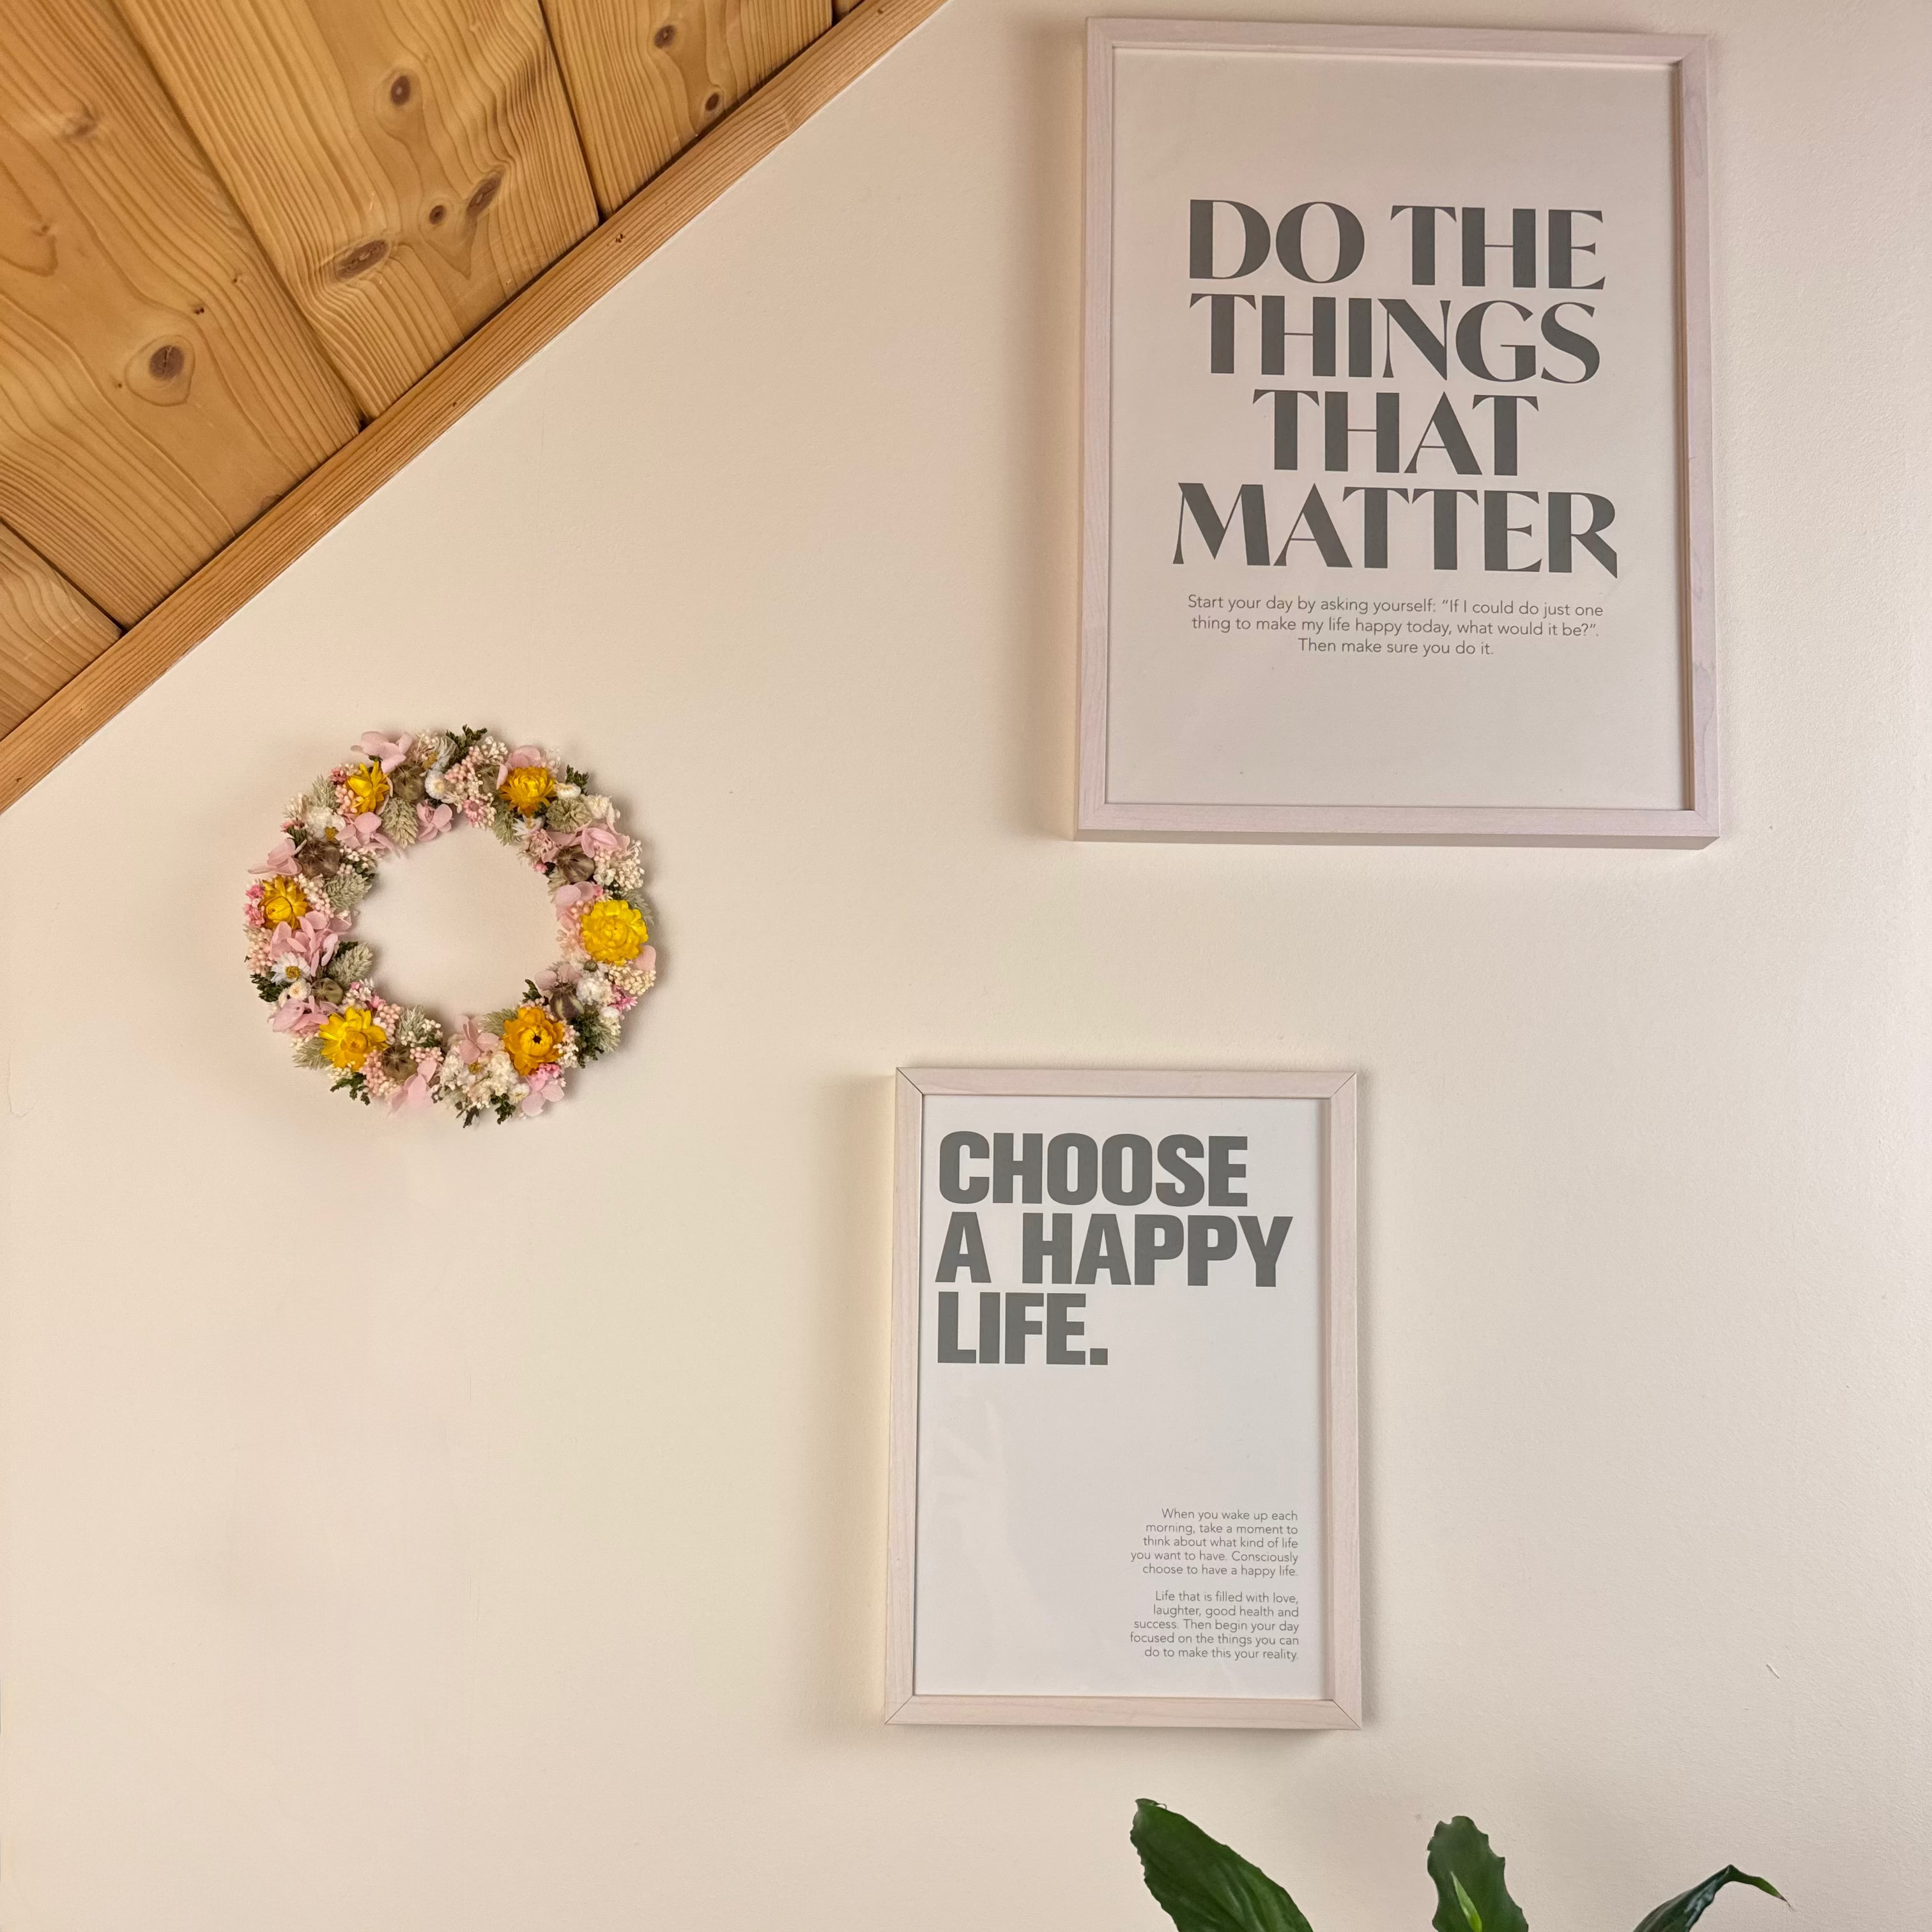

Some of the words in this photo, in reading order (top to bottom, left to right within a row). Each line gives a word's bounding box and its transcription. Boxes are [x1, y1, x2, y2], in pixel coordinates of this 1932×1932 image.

[1189, 199, 1365, 284] DO
[1390, 205, 1606, 290] THE
[1189, 293, 1600, 384] THINGS
[1252, 388, 1539, 476] THAT
[1172, 482, 1618, 579] MATTER
[1188, 594, 1224, 609] Start
[1228, 599, 1262, 613] your
[1266, 594, 1294, 614] day
[1298, 595, 1316, 614] by
[1321, 596, 1368, 615] asking
[1372, 597, 1436, 615] yourself:
[1464, 599, 1467, 613] I
[1472, 599, 1514, 615] could
[1519, 600, 1539, 615] do
[1542, 602, 1571, 619] just
[1575, 602, 1604, 617] one
[1191, 614, 1230, 634] thing
[1235, 618, 1251, 630] to
[1256, 615, 1296, 631] make
[1301, 620, 1324, 635] my
[1329, 616, 1350, 632] life
[1355, 617, 1403, 636] happy
[1406, 618, 1452, 637] today,
[1457, 619, 1493, 634] what
[1497, 621, 1543, 636] would
[1548, 622, 1558, 636] it
[1298, 637, 1336, 652] Then
[1342, 638, 1382, 653] make
[1386, 640, 1418, 654] sure
[1422, 644, 1450, 657] you
[1455, 640, 1476, 655] do
[1481, 641, 1494, 655] it.
[939, 1131, 1248, 1208] CHOOSE
[935, 1211, 992, 1284] A
[1022, 1213, 1293, 1287] HAPPY
[937, 1291, 1108, 1365] LIFE.
[1161, 1507, 1195, 1519] When
[1197, 1512, 1218, 1522] you
[1221, 1508, 1250, 1520] wake
[1254, 1512, 1268, 1524] up
[1271, 1510, 1298, 1521] each
[1146, 1524, 1195, 1536] morning,
[1199, 1522, 1223, 1533] take
[1226, 1526, 1232, 1534] a
[1236, 1525, 1284, 1535] moment
[1285, 1525, 1298, 1535] to
[1142, 1535, 1170, 1546] think
[1173, 1535, 1207, 1547] about
[1209, 1536, 1237, 1547] what
[1240, 1536, 1264, 1548] kind
[1267, 1537, 1280, 1548] of
[1282, 1537, 1299, 1549] life
[1130, 1552, 1151, 1563] you
[1154, 1551, 1181, 1560] want
[1184, 1551, 1196, 1561] to
[1199, 1549, 1227, 1561] have.
[1231, 1550, 1299, 1566] Consciously
[1142, 1562, 1184, 1575] choose
[1186, 1565, 1199, 1575] to
[1201, 1563, 1227, 1575] have
[1230, 1567, 1238, 1575] a
[1241, 1563, 1276, 1579] happy
[1279, 1565, 1298, 1577] life.
[1155, 1590, 1176, 1601] Life
[1177, 1590, 1201, 1602] that
[1204, 1591, 1213, 1602] is
[1215, 1590, 1243, 1602] filled
[1245, 1591, 1269, 1603] with
[1273, 1591, 1299, 1606] love,
[1153, 1604, 1202, 1618] laughter,
[1205, 1604, 1236, 1619] good
[1239, 1605, 1275, 1617] health
[1277, 1606, 1299, 1618] and
[1133, 1621, 1179, 1630] success.
[1182, 1618, 1211, 1630] Then
[1215, 1618, 1248, 1634] begin
[1250, 1622, 1276, 1634] your
[1278, 1620, 1300, 1635] day
[1130, 1630, 1175, 1643] focused
[1177, 1636, 1192, 1644] on
[1195, 1632, 1215, 1644] the
[1216, 1632, 1252, 1648] things
[1255, 1637, 1276, 1648] you
[1279, 1637, 1300, 1646] can
[1144, 1645, 1160, 1657] do
[1163, 1648, 1175, 1657] to
[1178, 1646, 1209, 1658] make
[1211, 1646, 1232, 1659] this
[1234, 1650, 1260, 1661] your
[1262, 1648, 1299, 1662] reality.
